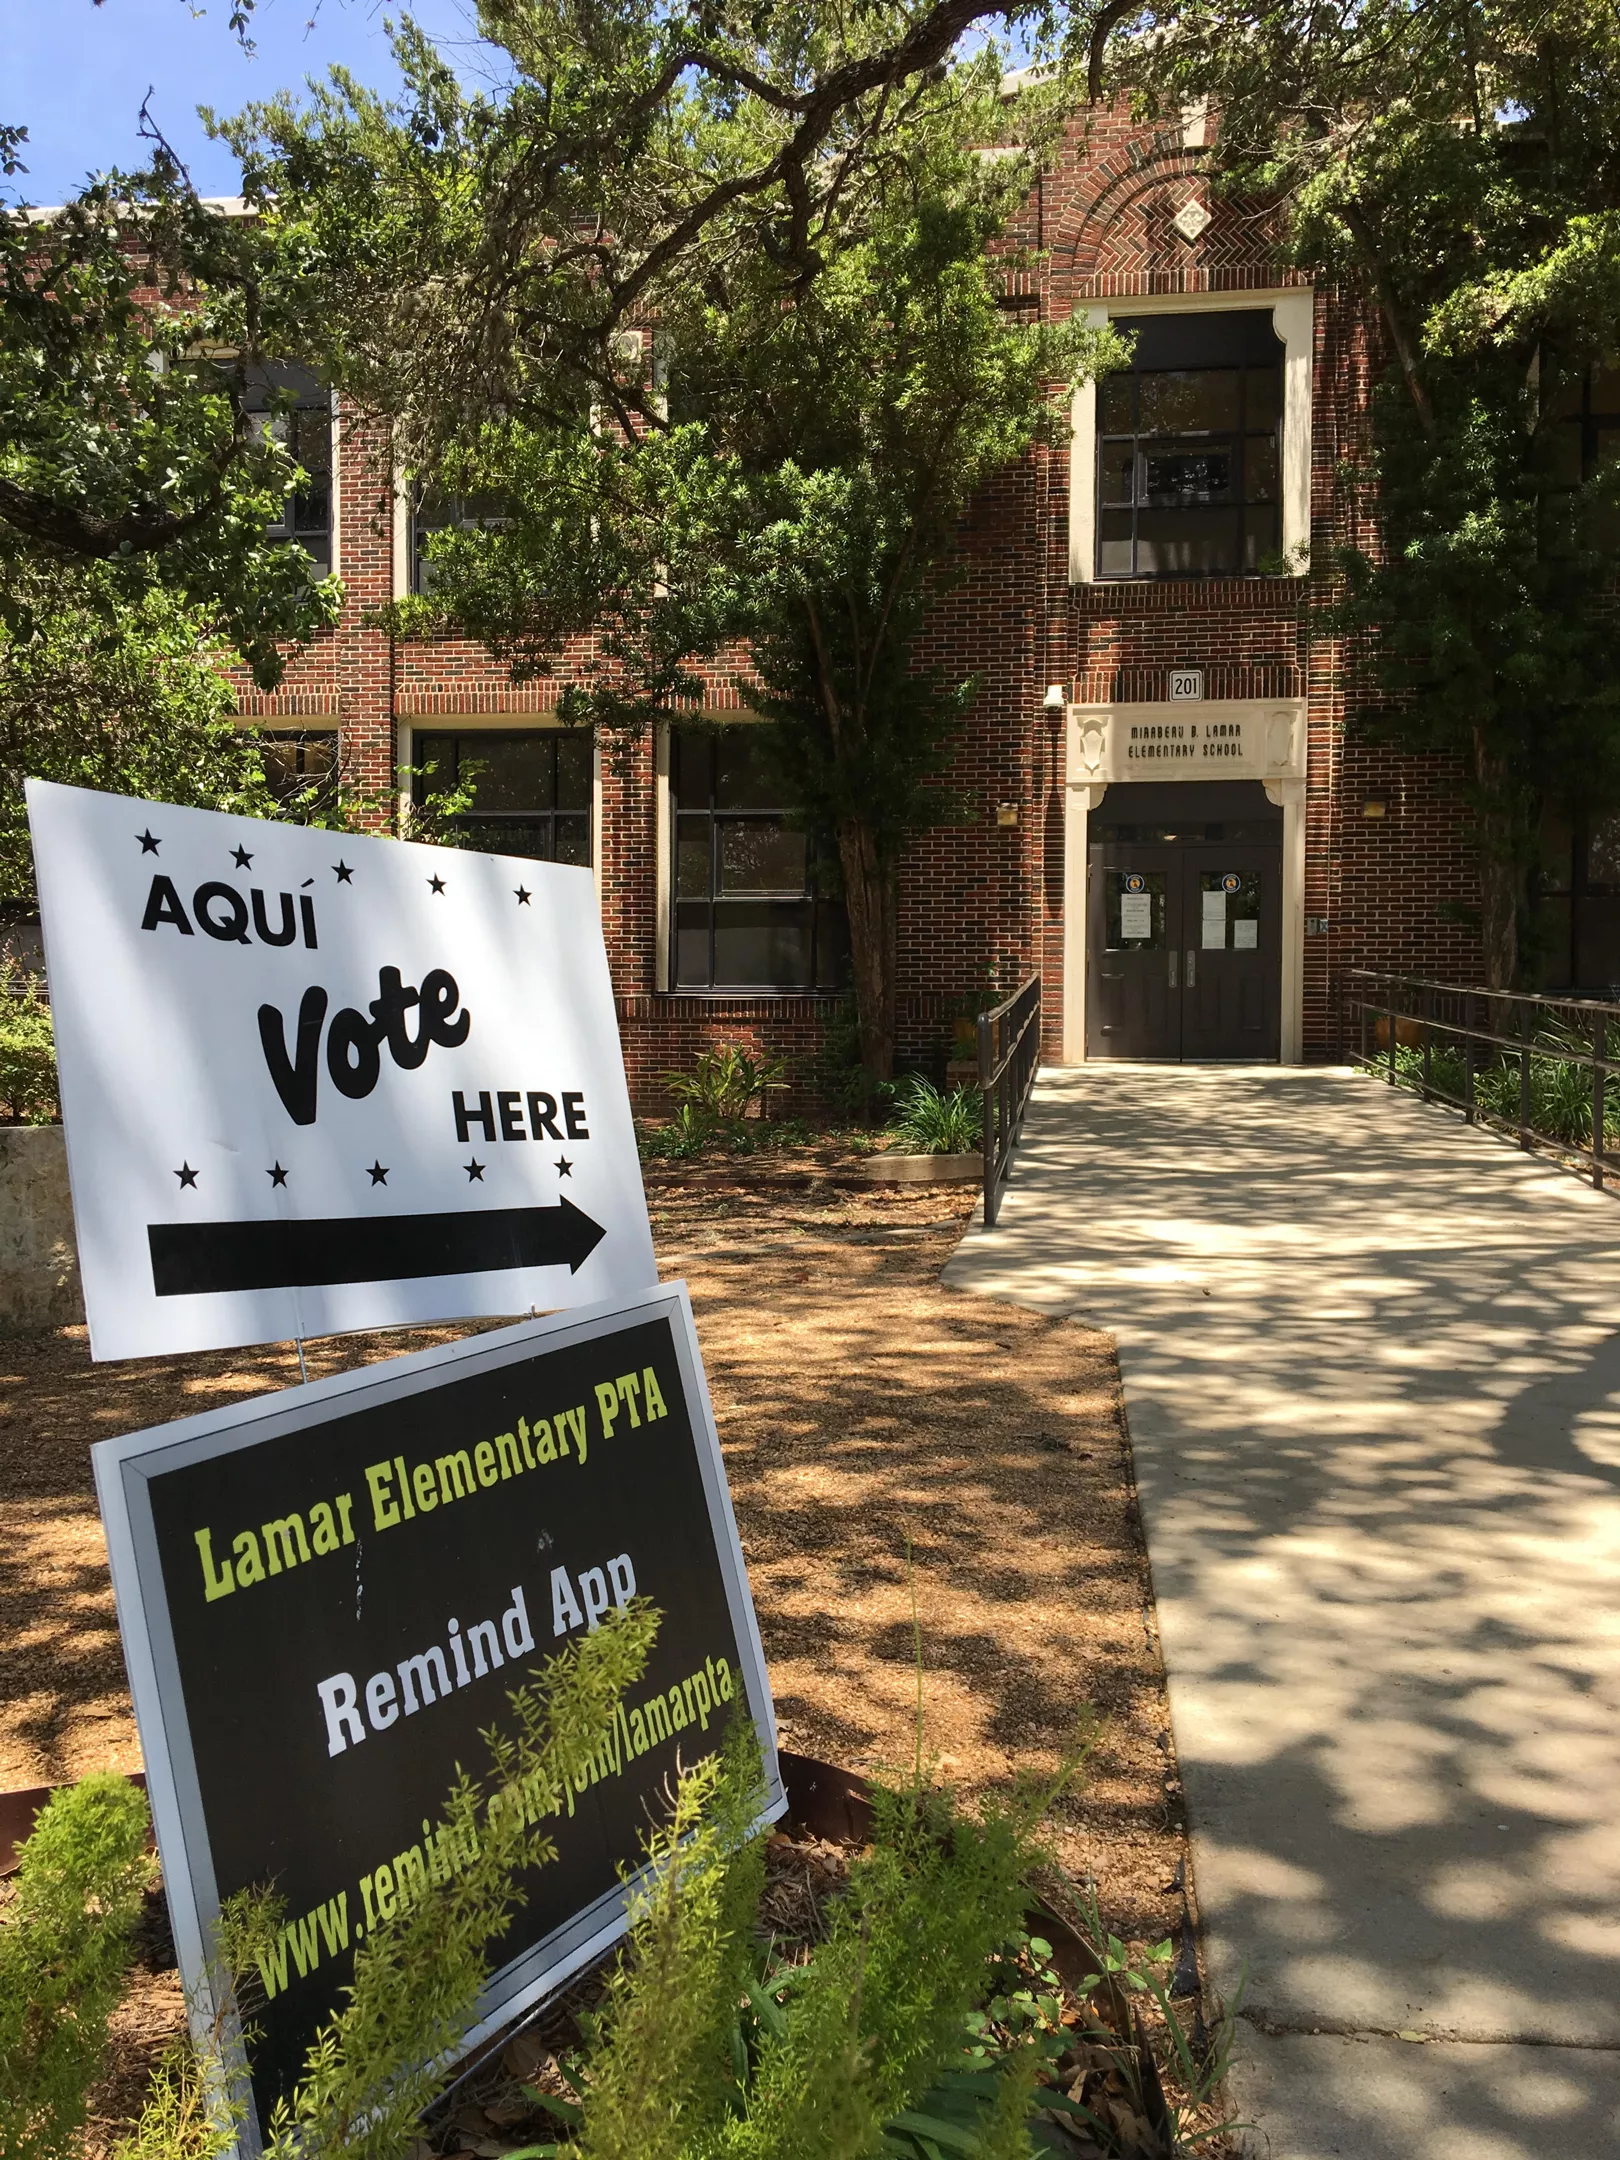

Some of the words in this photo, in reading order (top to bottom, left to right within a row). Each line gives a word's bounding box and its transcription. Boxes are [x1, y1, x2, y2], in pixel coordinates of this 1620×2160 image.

[1175, 678, 1196, 694] 201
[1128, 744, 1195, 758] ELEMENTARY
[1203, 743, 1243, 757] SCHOOL
[1131, 725, 1183, 739] MIRABEAU
[1190, 725, 1198, 738] B.
[1206, 724, 1241, 738] LAMAR
[141, 874, 318, 949] AQUÍ
[258, 965, 471, 1126] Vote
[452, 1090, 590, 1142] HERE
[194, 1492, 356, 1603] Lamar
[364, 1404, 587, 1532] Elementary
[594, 1366, 668, 1439] PTA
[317, 1583, 536, 1758] Remind
[550, 1552, 638, 1638] App
